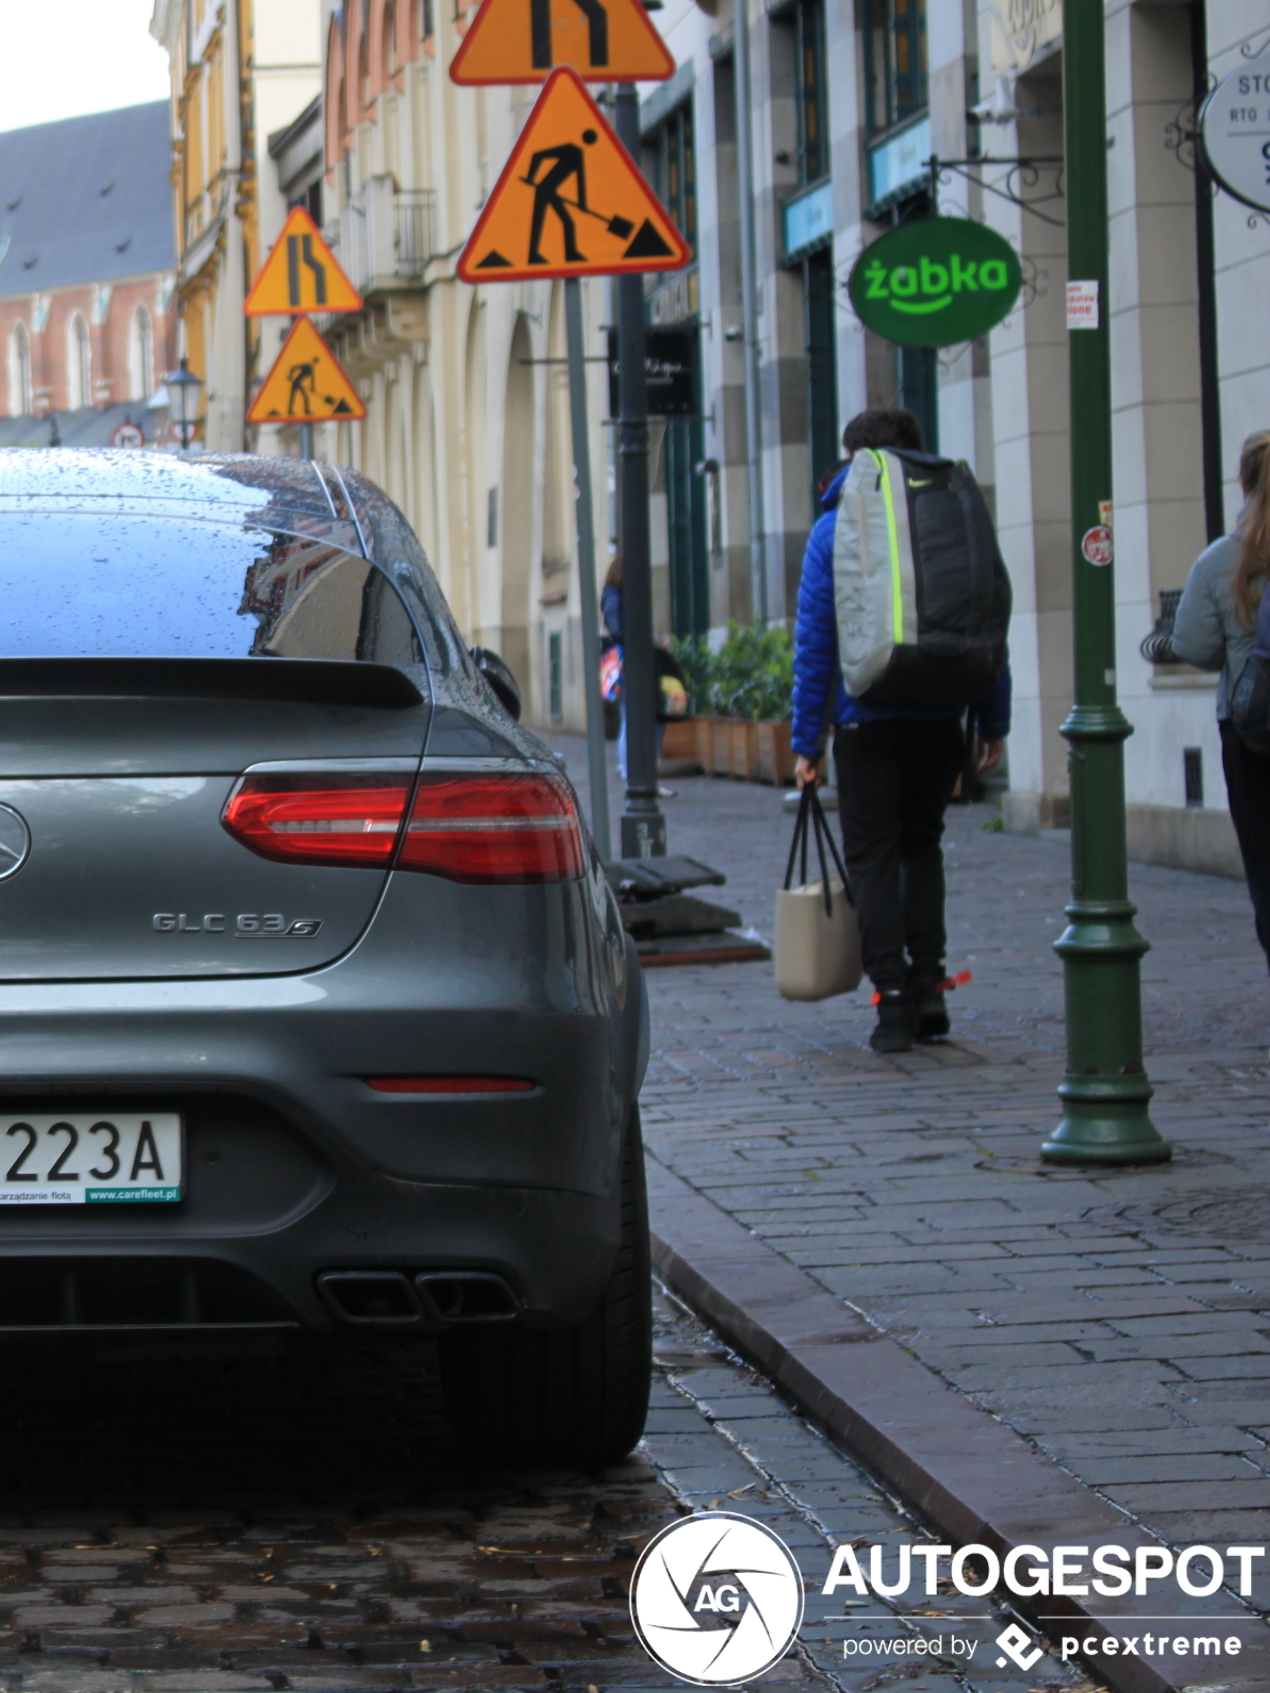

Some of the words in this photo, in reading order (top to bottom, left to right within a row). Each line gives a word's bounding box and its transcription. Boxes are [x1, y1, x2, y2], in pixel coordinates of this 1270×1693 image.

[864, 254, 1008, 299] żabka
[153, 913, 225, 932] GLC
[90, 1189, 177, 1201] www.carefleet.pl
